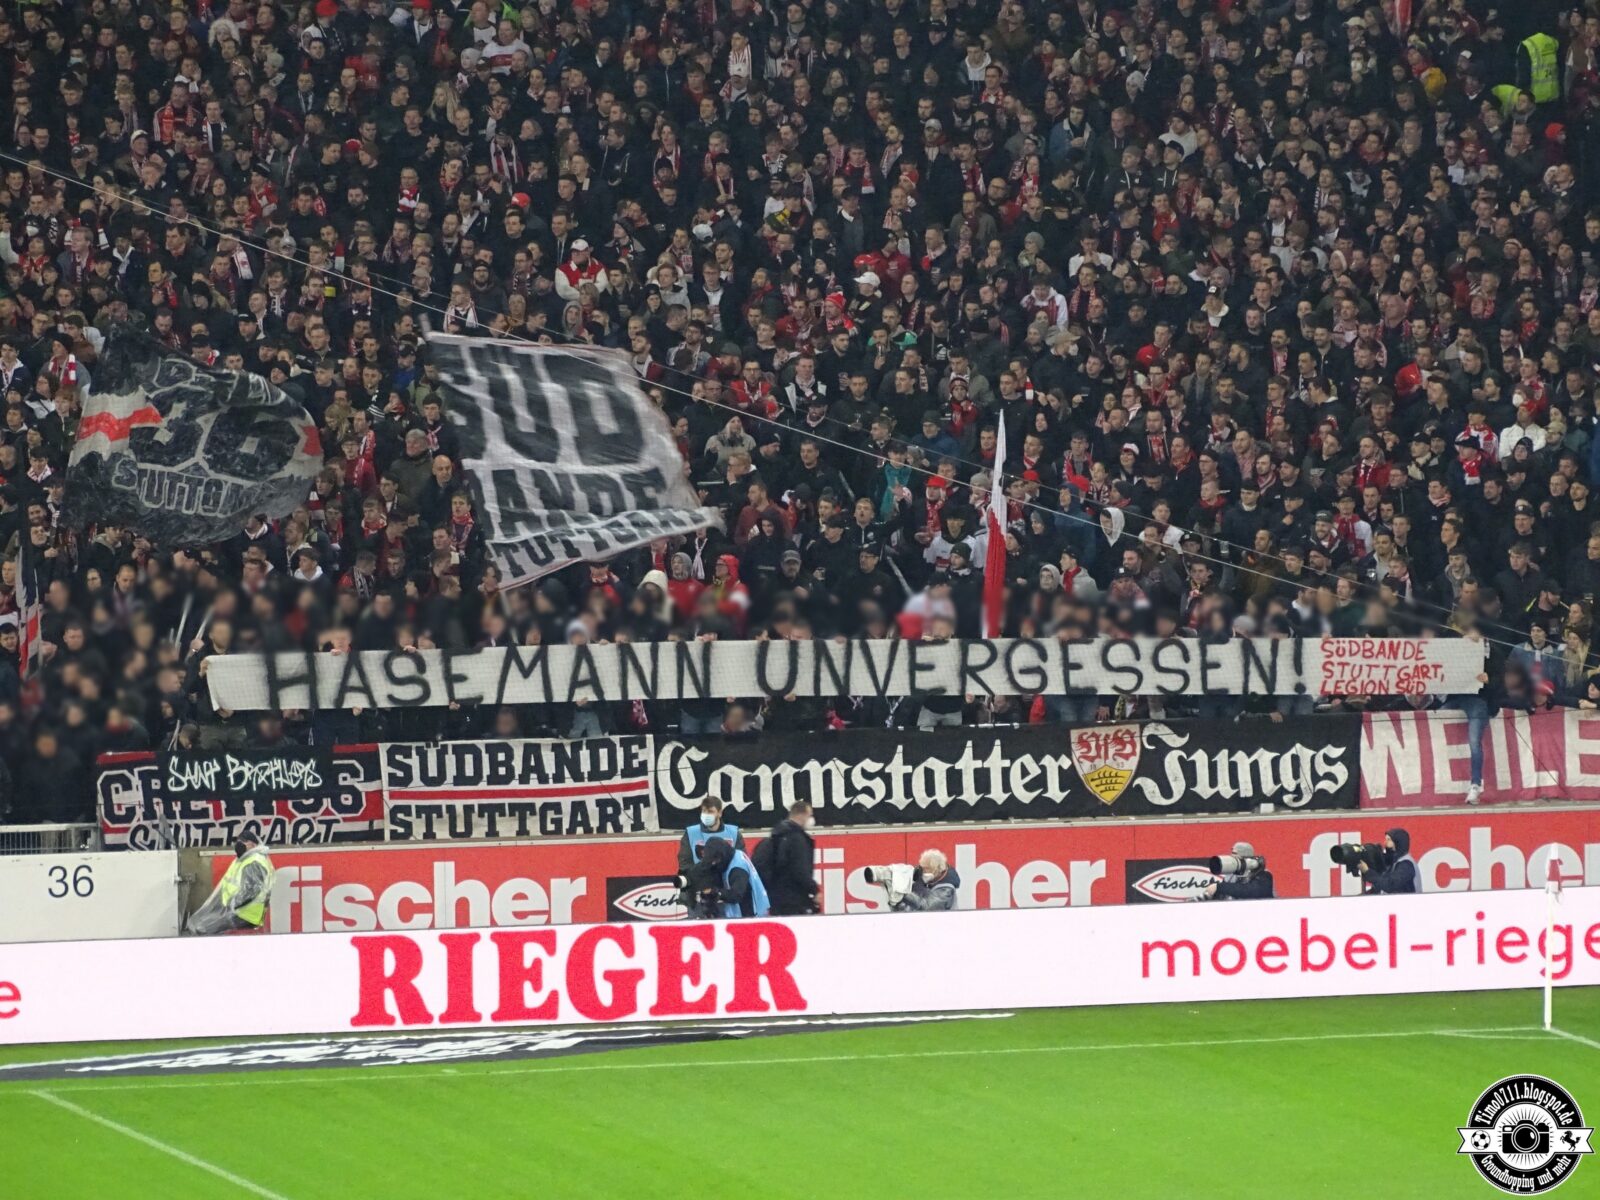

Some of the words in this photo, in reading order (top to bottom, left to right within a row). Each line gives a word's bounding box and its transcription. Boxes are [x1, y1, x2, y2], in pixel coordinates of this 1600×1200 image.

[266, 640, 713, 709] HASEMANN
[756, 636, 1307, 697] UNVERGESSEN!
[1320, 680, 1390, 696] LEGION
[1322, 661, 1445, 682] STUTTGART,
[386, 735, 649, 788] SÜDBANDE
[657, 739, 1071, 812] Cannstatter
[1133, 722, 1349, 808] Jungs
[389, 794, 650, 840] STUTTGART
[48, 865, 95, 898] 36
[270, 861, 587, 933] fischer
[350, 922, 808, 1026] RIEGER
